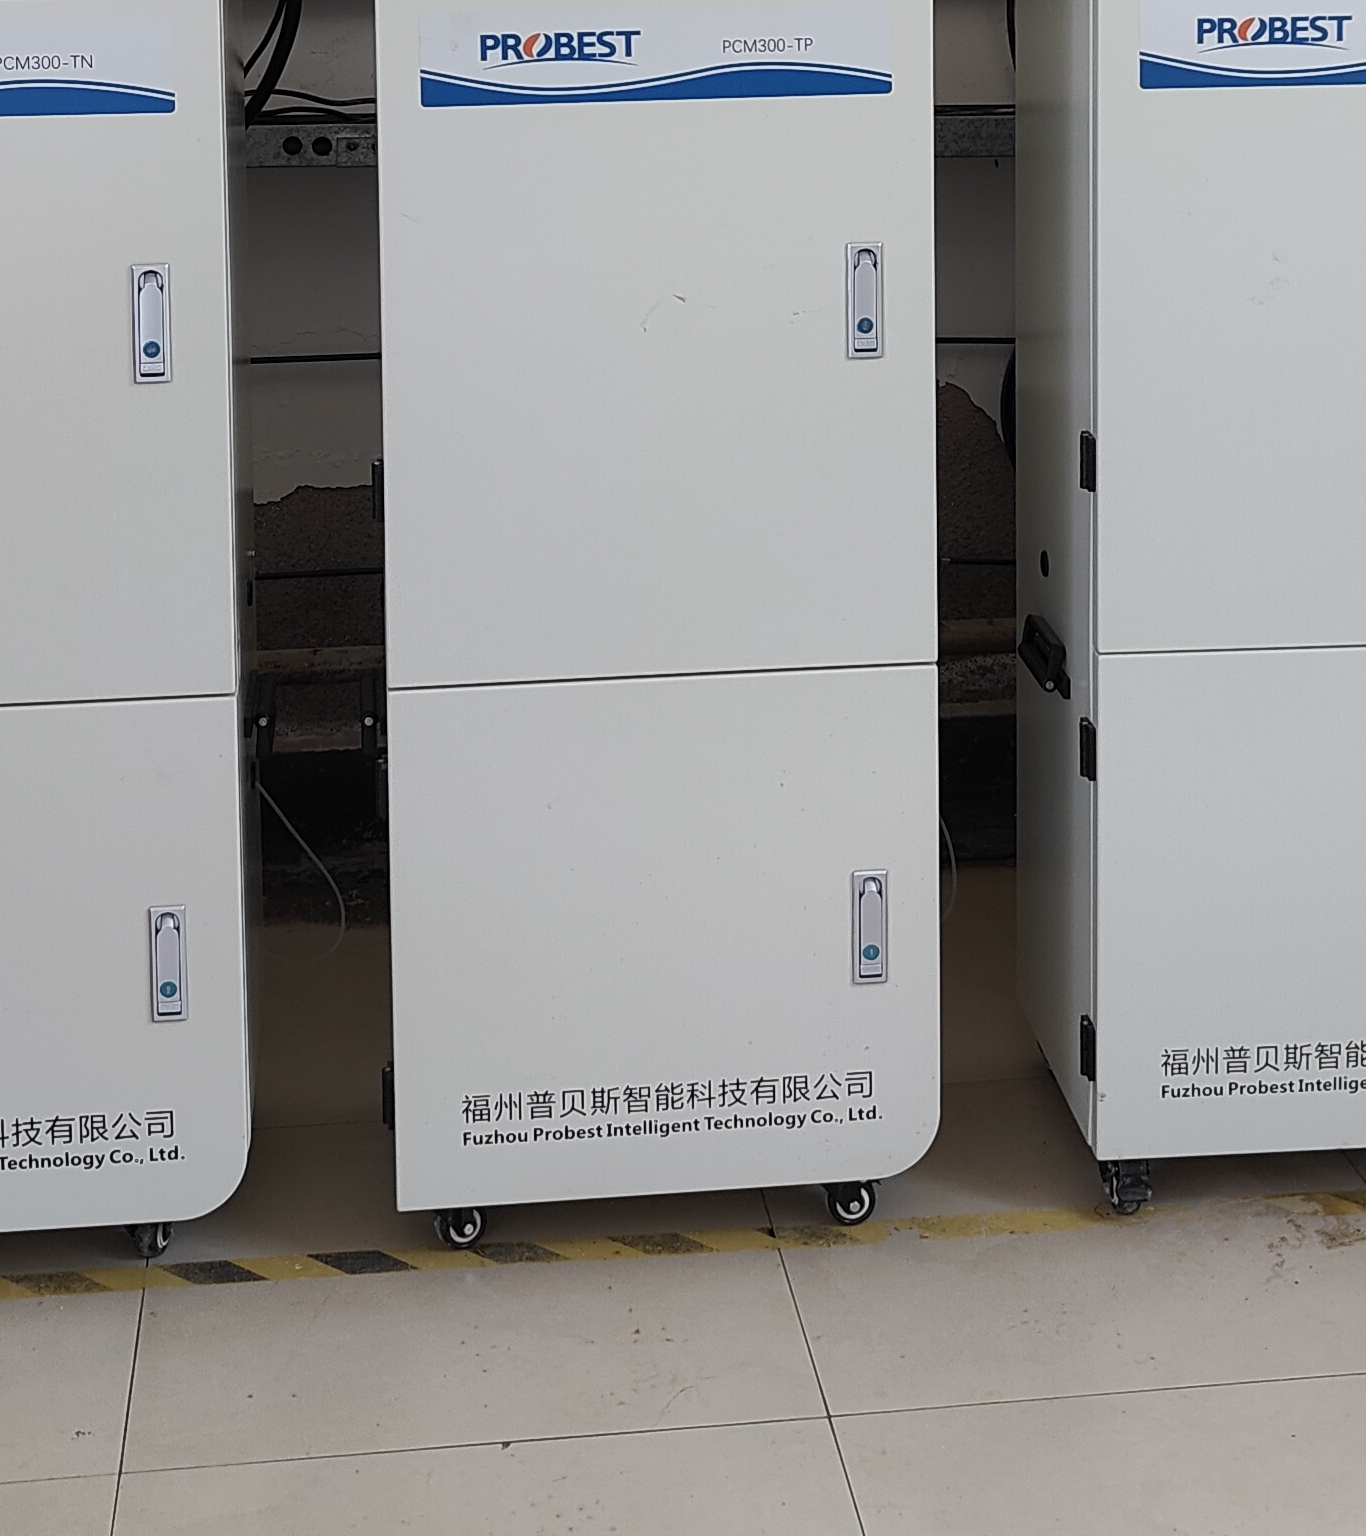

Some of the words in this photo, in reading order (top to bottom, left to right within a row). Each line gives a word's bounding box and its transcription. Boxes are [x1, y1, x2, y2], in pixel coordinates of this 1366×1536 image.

[1197, 15, 1353, 44] PROBEST
[480, 31, 641, 62] PROBEST
[722, 37, 814, 54] PCM300-TP
[462, 1071, 872, 1123] 福州普贝斯智能科技有限公司
[1162, 1083, 1223, 1098] Fuzhou
[1229, 1080, 1294, 1095] Probest
[463, 1130, 527, 1146] Fuzhou
[534, 1125, 602, 1141] Probest
[607, 1119, 700, 1137] Intelligent
[704, 1112, 806, 1130] Technology
[811, 1110, 843, 1124] Co.,
[849, 1105, 882, 1121] Ltd.
[110, 1150, 143, 1164] Co.,
[150, 1146, 185, 1161] Ltd.
